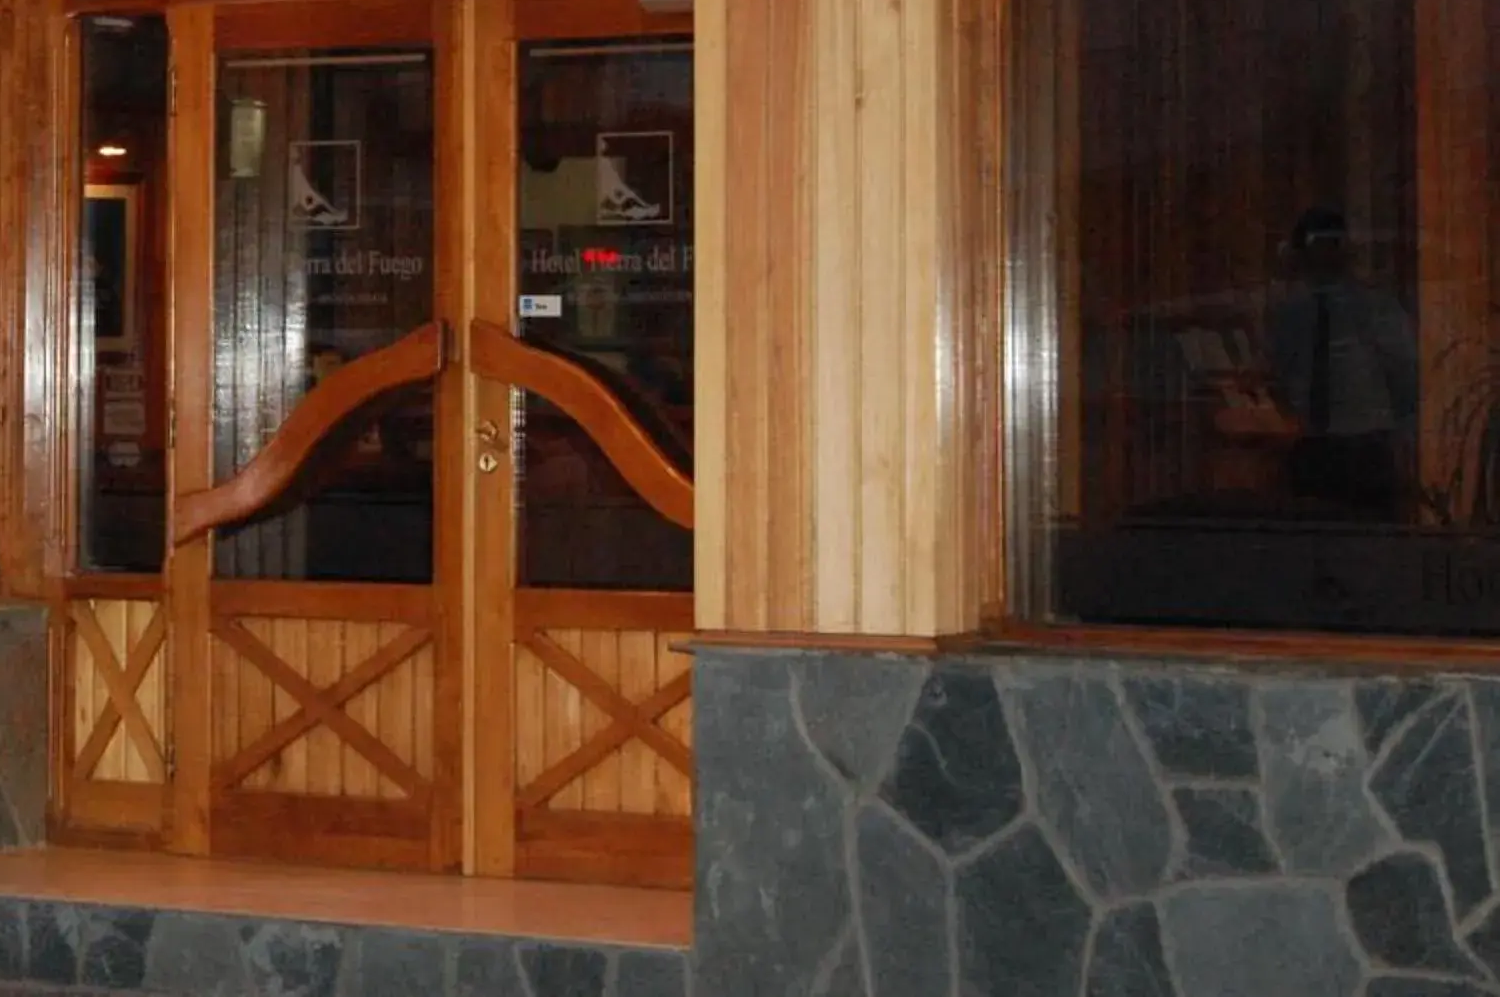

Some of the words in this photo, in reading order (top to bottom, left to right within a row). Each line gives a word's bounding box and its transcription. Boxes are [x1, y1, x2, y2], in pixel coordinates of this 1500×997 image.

[334, 248, 363, 275] del
[368, 251, 423, 281] Fuego
[531, 247, 581, 274] Hotel
[647, 244, 675, 272] del
